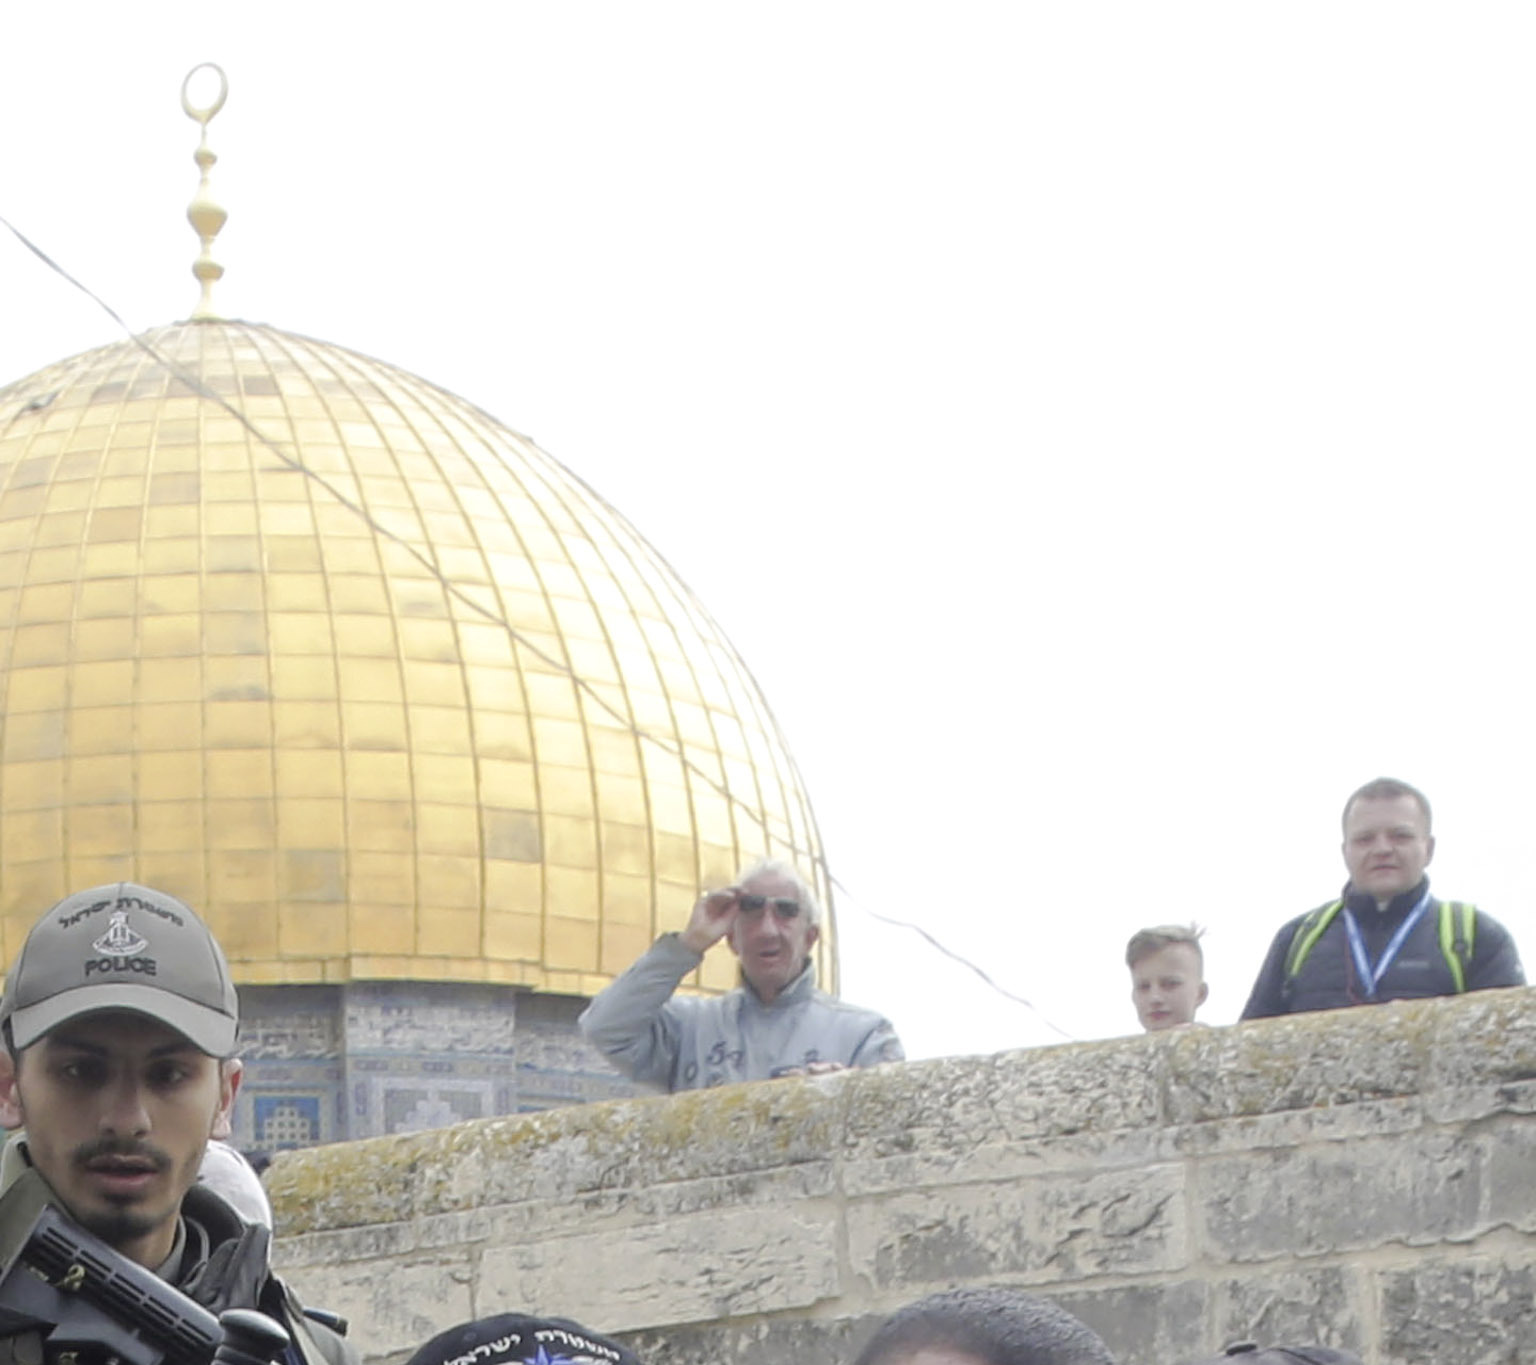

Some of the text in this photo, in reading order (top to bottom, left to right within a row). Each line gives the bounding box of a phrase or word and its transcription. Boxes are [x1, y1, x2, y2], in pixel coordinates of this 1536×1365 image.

[59, 901, 112, 928] ישראל
[85, 956, 157, 977] POLICE
[534, 1330, 621, 1361] משטרת
